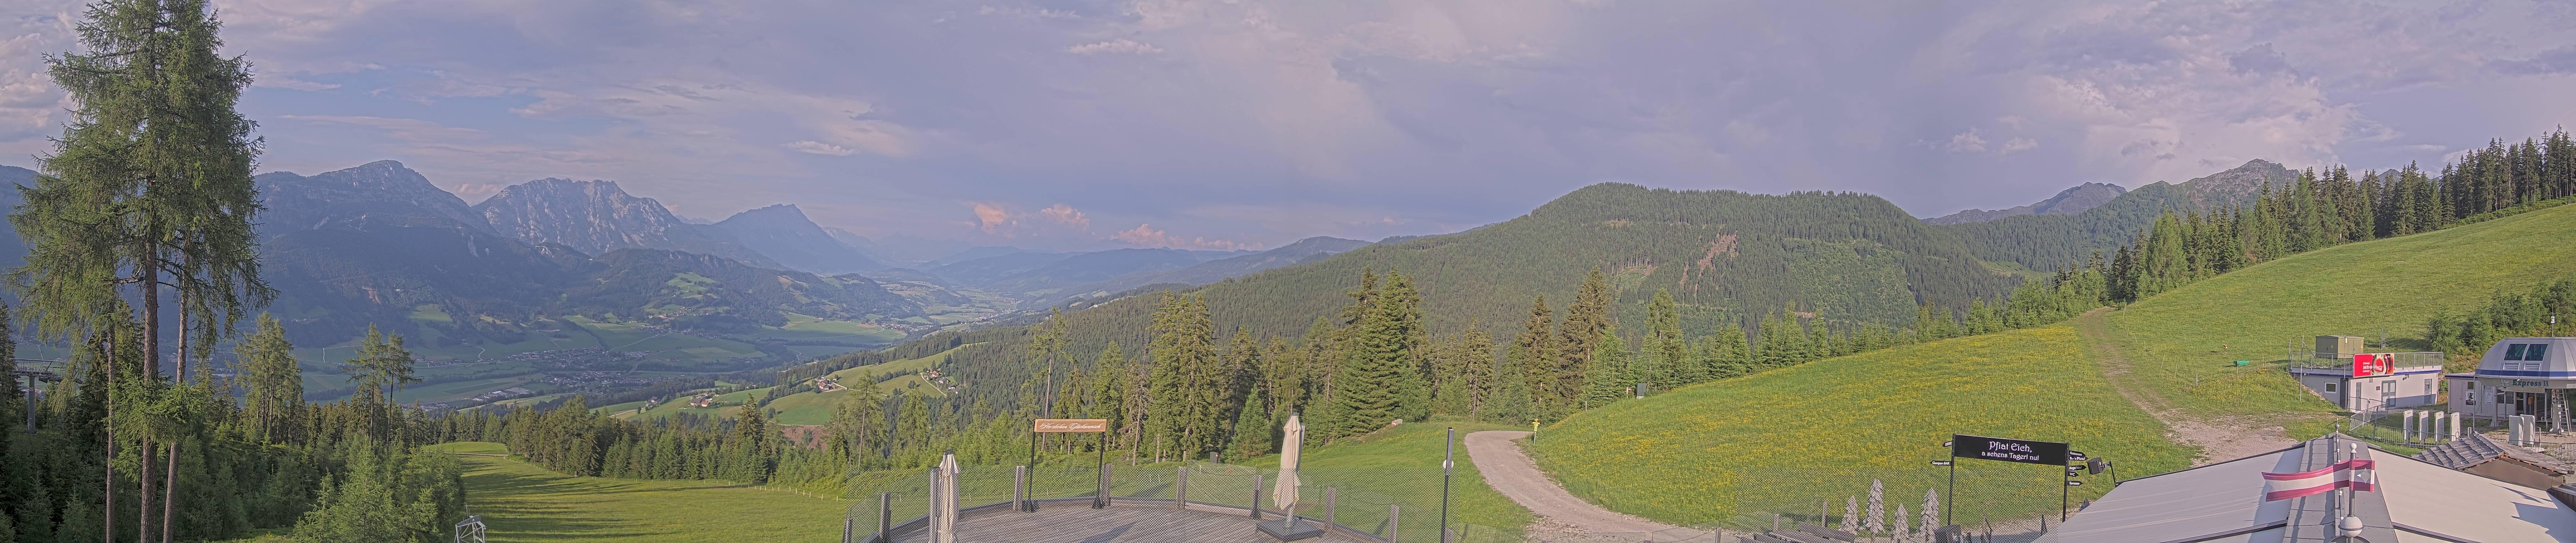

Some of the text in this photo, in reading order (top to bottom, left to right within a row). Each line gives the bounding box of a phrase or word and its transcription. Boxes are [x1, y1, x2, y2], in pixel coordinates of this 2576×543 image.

[2512, 379, 2542, 387] Express
[1989, 441, 2032, 453] Pfiat Eich,
